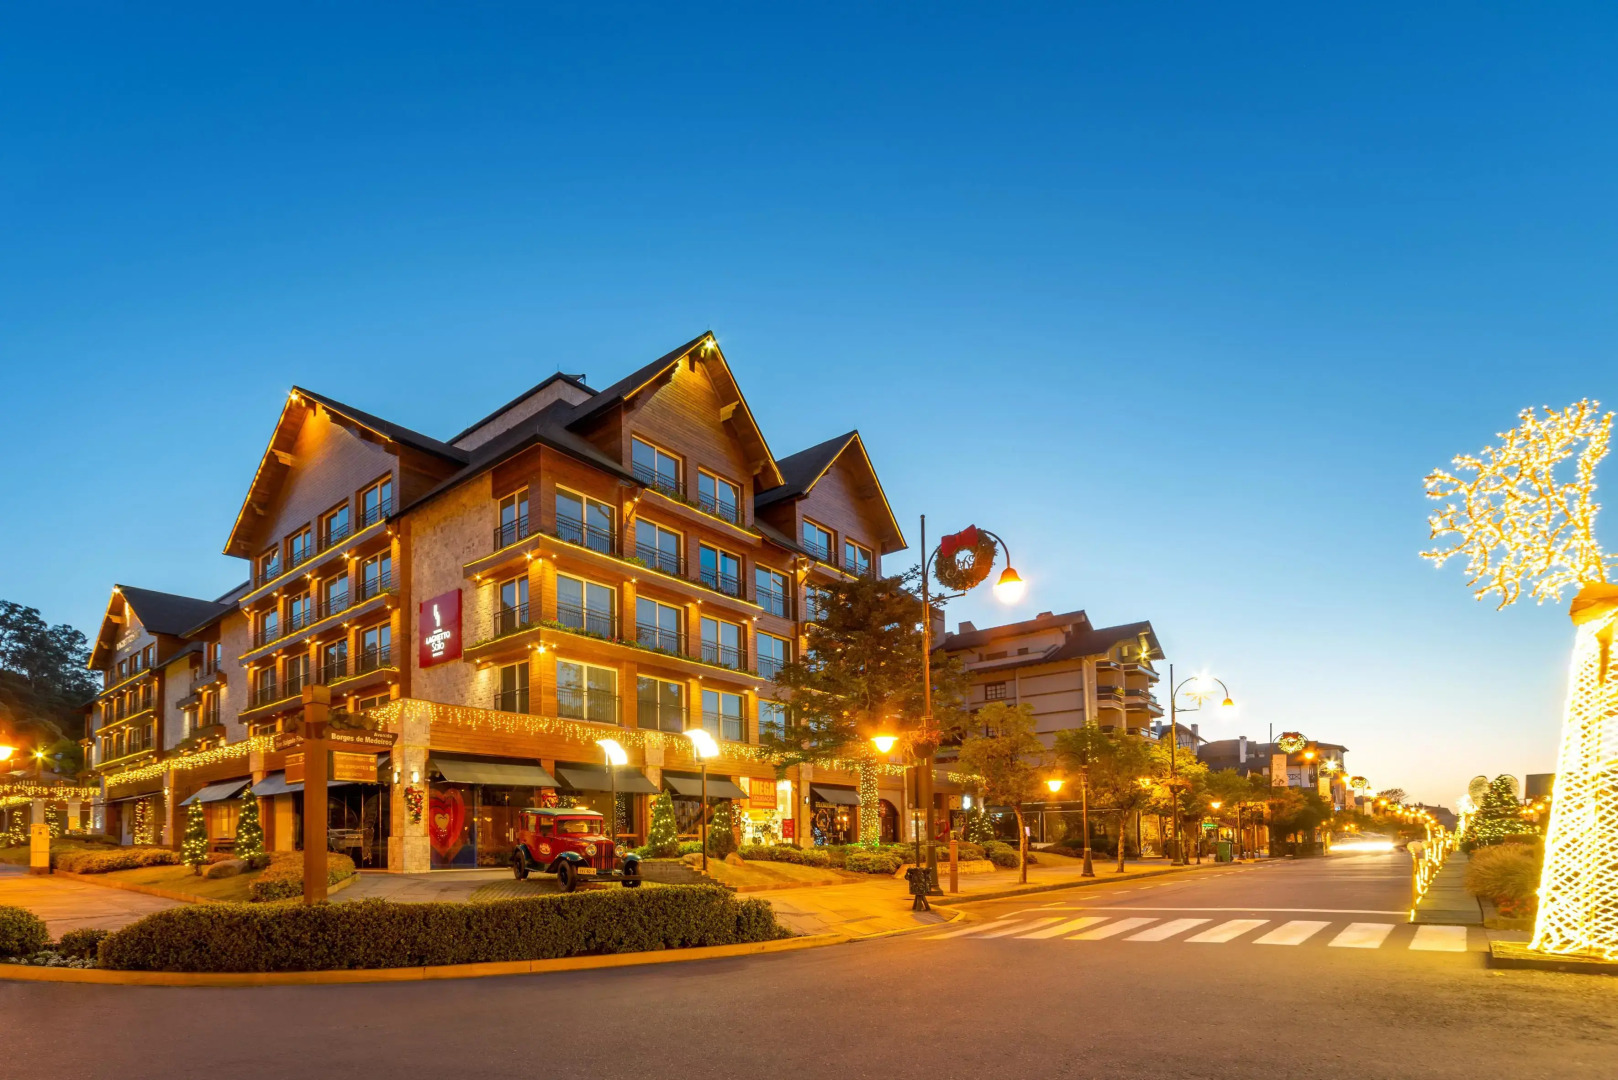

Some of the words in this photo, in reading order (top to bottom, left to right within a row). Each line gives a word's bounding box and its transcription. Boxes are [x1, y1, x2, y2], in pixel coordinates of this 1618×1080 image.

[331, 732, 354, 742] Borges
[365, 736, 393, 746] Medeiros
[751, 780, 775, 796] MEGA
